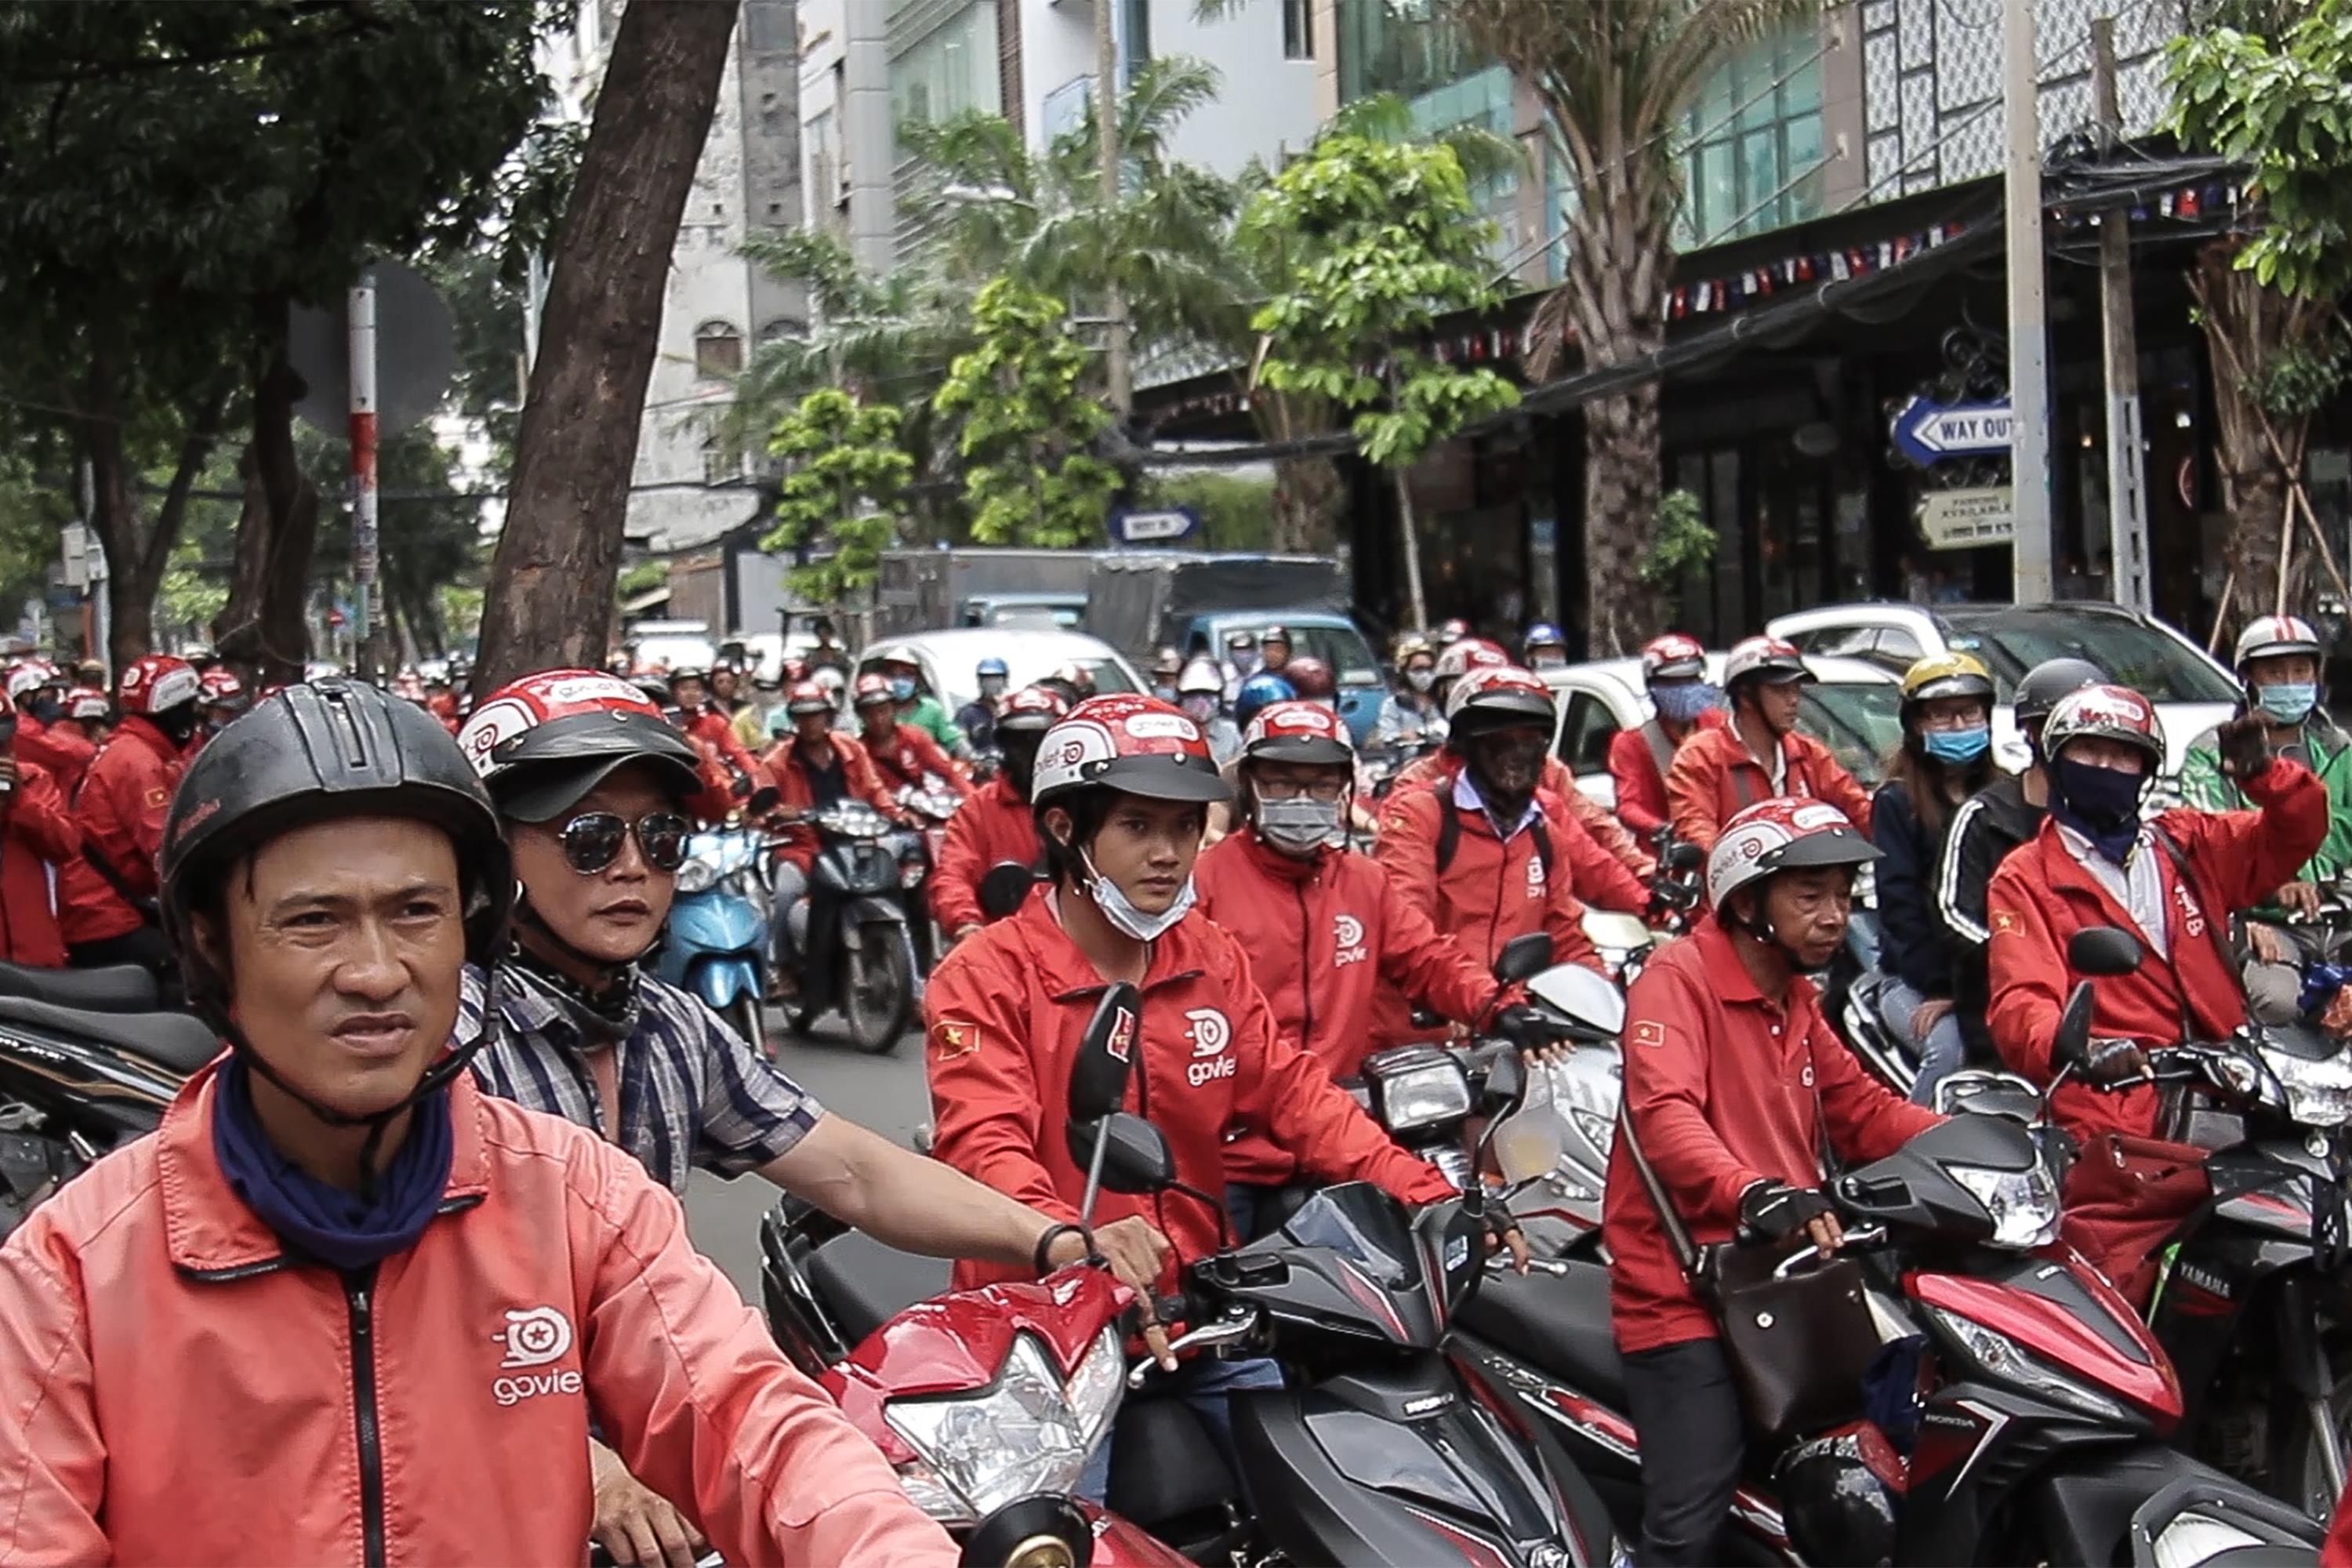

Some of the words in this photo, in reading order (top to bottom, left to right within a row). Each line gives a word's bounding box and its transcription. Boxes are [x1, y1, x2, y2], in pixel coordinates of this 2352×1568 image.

[1940, 420, 1977, 441] WAY
[1187, 1054, 1237, 1087] govie
[2180, 1261, 2230, 1299] YAMAHA
[492, 1367, 582, 1406] govie
[1925, 1414, 1976, 1428] HONDA
